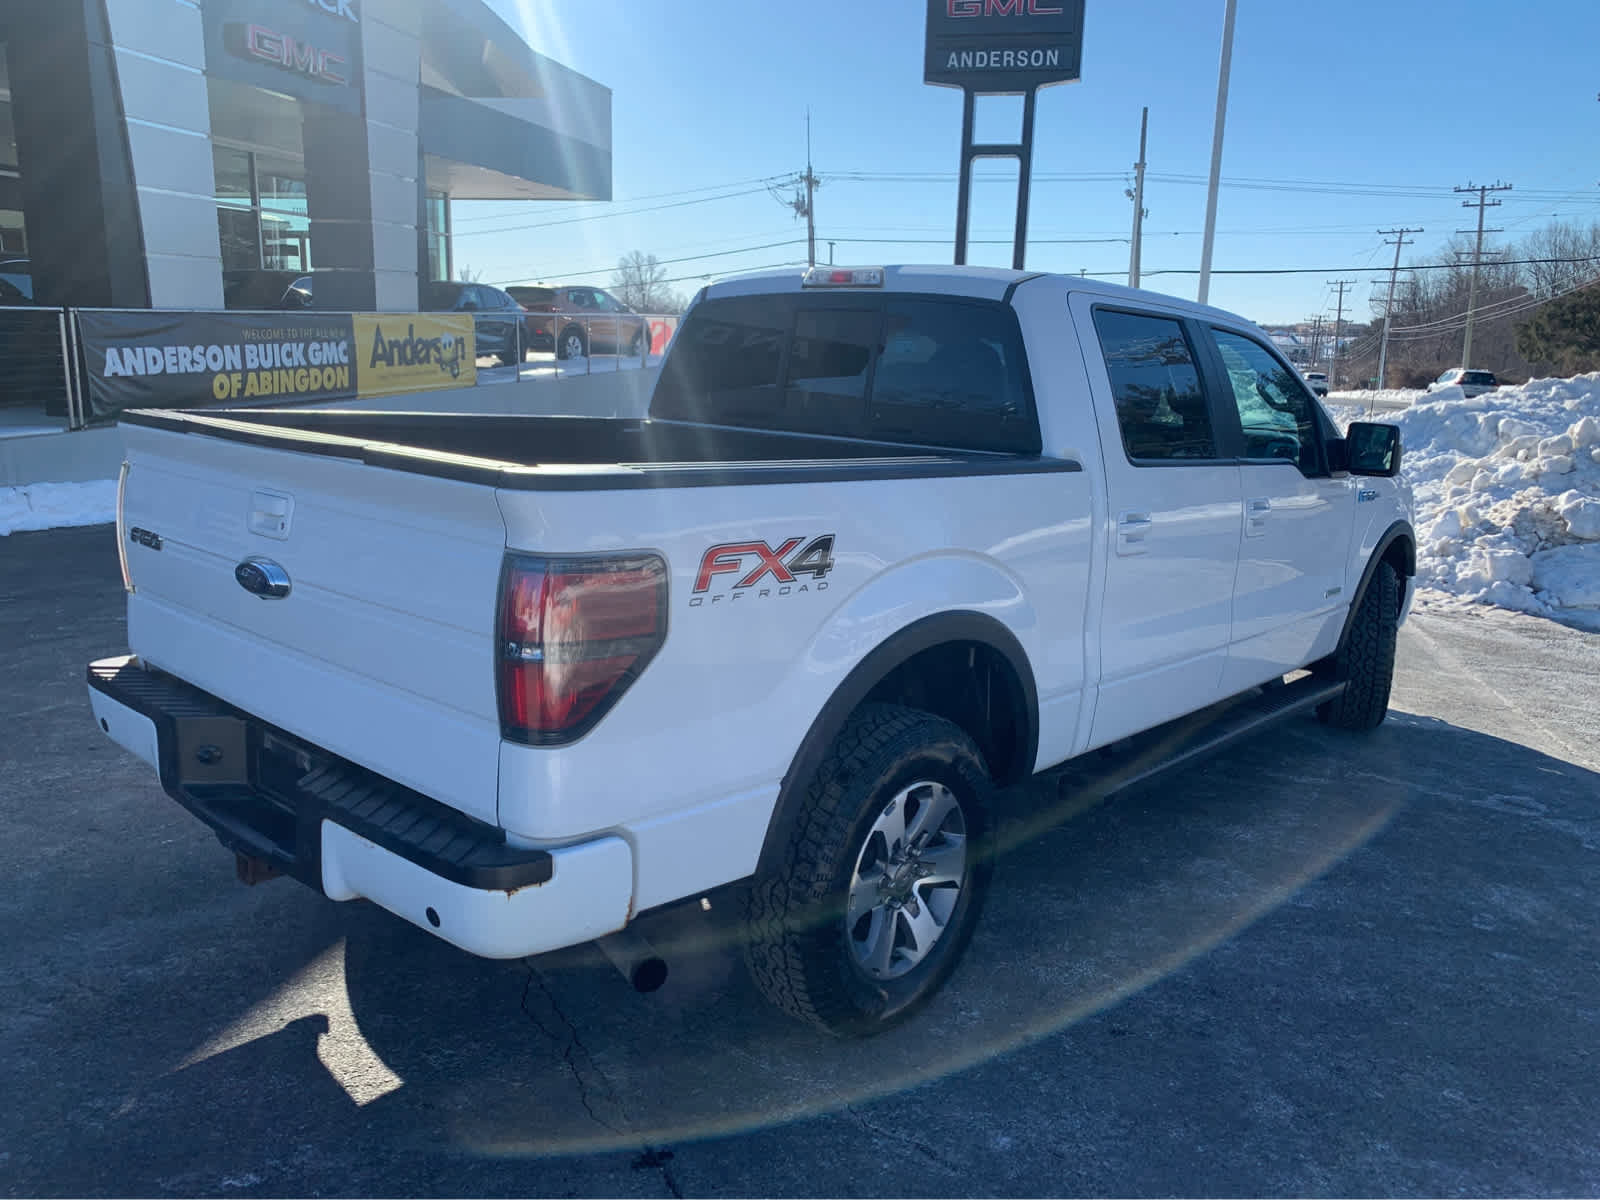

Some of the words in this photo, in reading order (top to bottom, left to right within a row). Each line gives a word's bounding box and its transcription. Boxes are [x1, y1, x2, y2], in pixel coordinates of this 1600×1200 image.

[248, 24, 345, 84] GMC
[947, 50, 1059, 68] ANDERSON
[241, 328, 285, 340] WELCOME
[287, 328, 298, 339] TO
[300, 328, 313, 338] THE
[104, 344, 242, 377] ANDERSON
[244, 343, 307, 370] BUICK
[308, 340, 349, 366] GMC
[213, 373, 242, 400] OF
[244, 366, 349, 397] ABINGDON
[692, 534, 836, 594] FX4
[688, 591, 745, 607] OFF
[758, 582, 829, 598] ROAD
